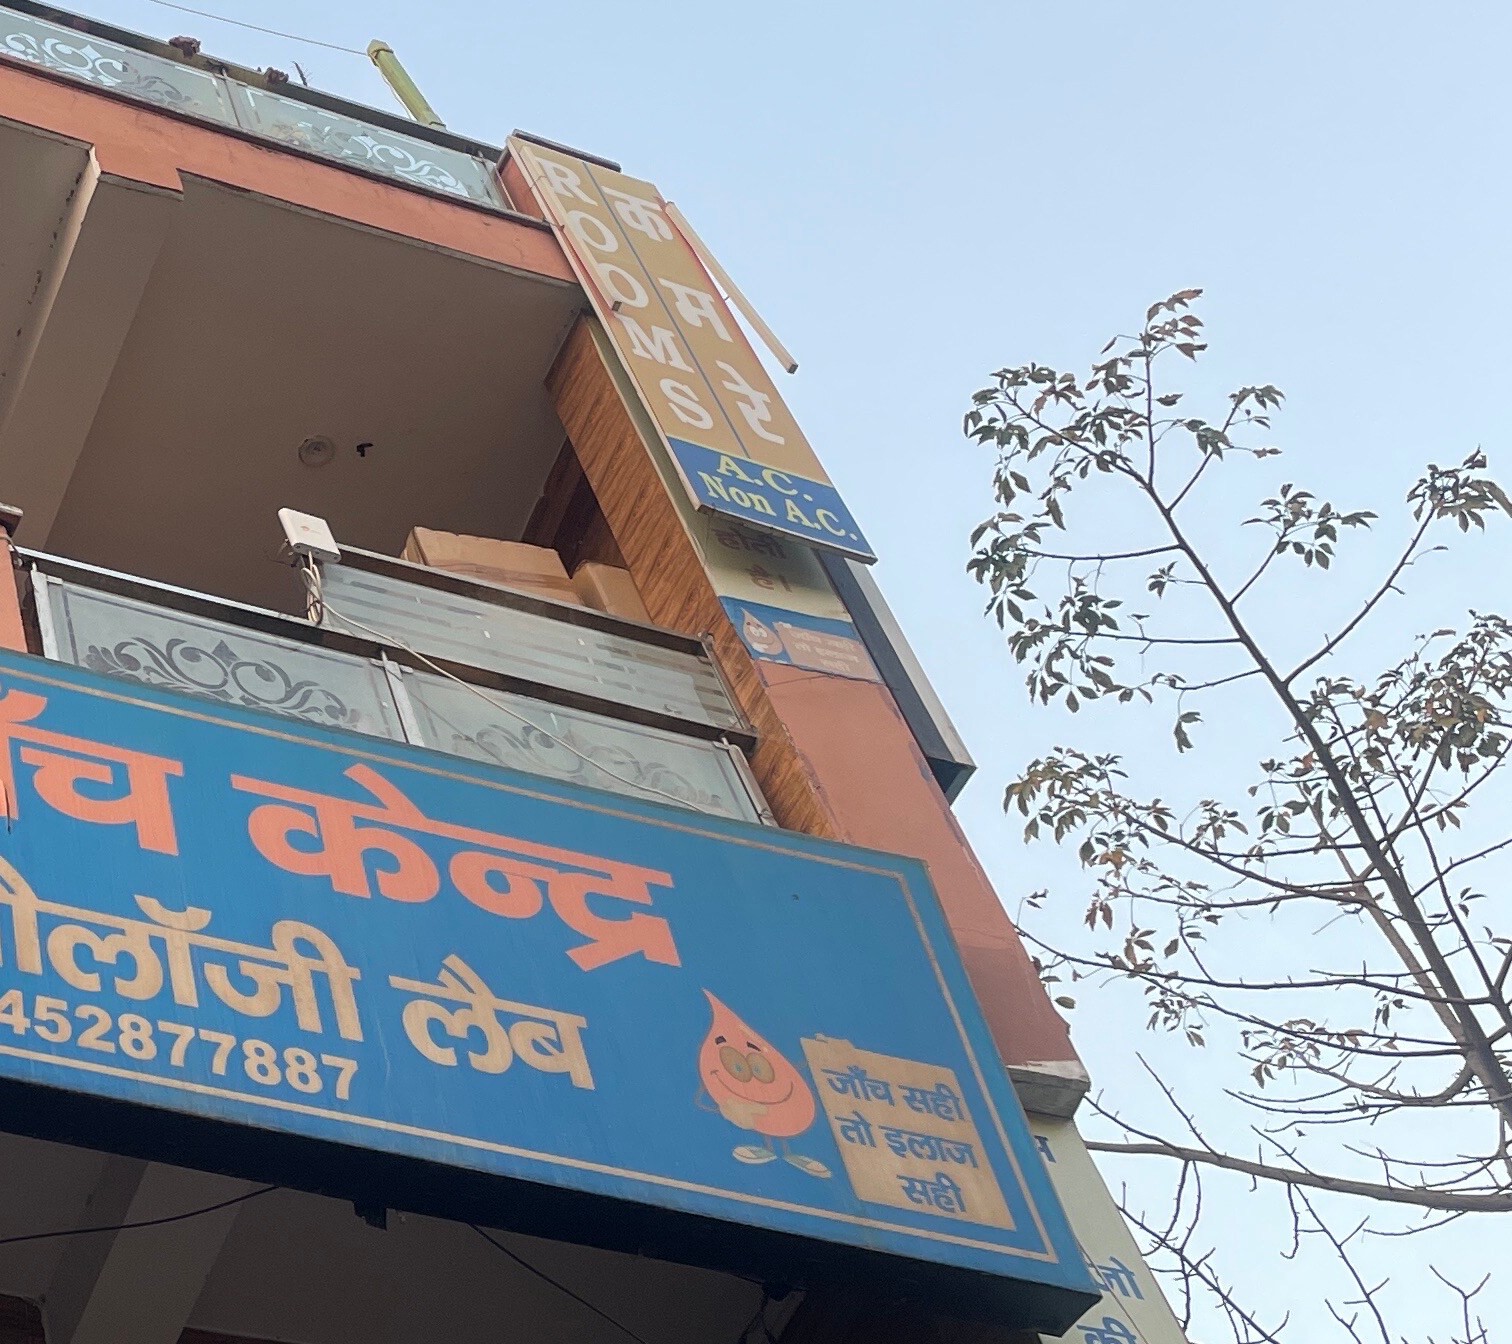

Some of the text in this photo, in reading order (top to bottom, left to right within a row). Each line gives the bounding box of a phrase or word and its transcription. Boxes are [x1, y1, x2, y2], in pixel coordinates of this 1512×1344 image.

[697, 471, 777, 517] Non
[716, 455, 813, 502] A.C.
[230, 764, 682, 972] केन्द्र
[388, 953, 595, 1090] लैब
[898, 1083, 965, 1121] सही
[835, 1110, 979, 1169] तो इलाज
[896, 1172, 966, 1213] सही
